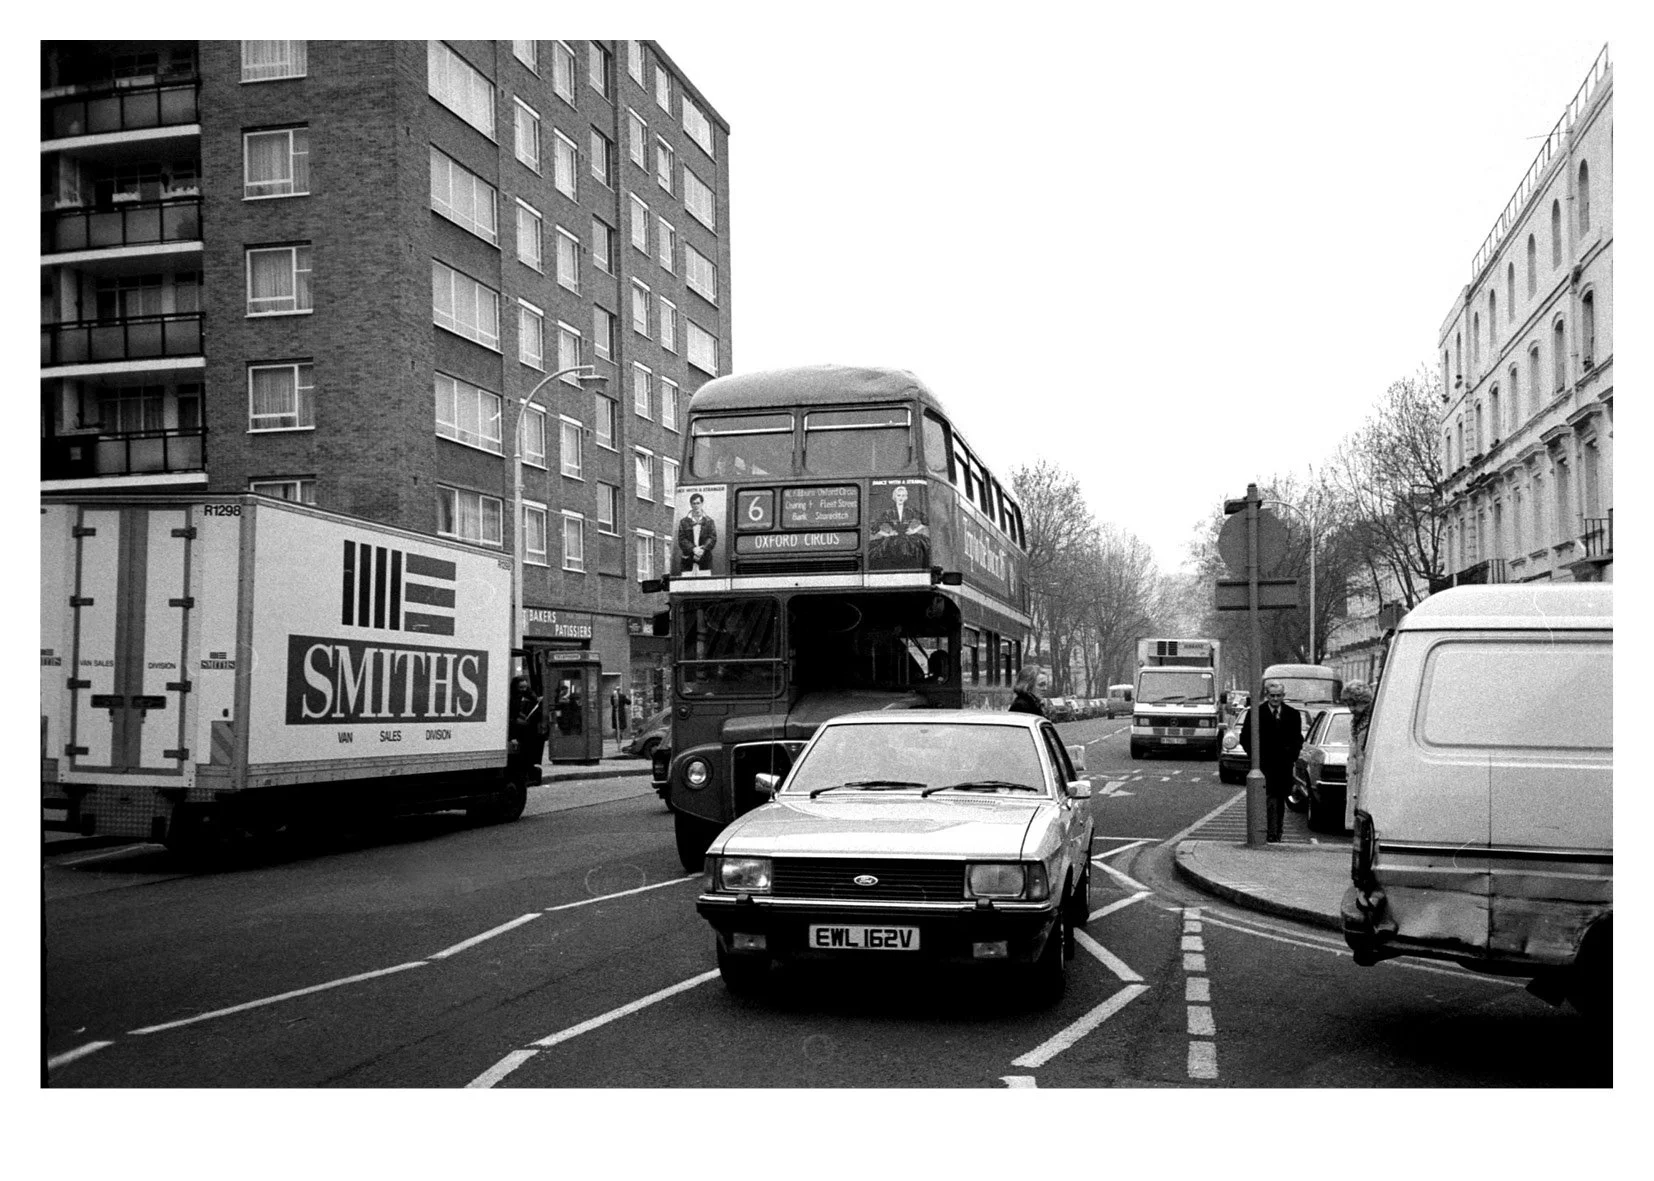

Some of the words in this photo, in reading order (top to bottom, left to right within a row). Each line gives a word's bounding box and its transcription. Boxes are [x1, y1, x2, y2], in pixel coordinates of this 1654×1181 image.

[748, 496, 764, 521] 6
[820, 499, 837, 508] Fleet
[838, 498, 858, 508] Street
[204, 505, 241, 516] R1298
[755, 534, 798, 548] OXFORD
[804, 532, 840, 546] CIRCUS
[529, 609, 557, 623] BAKERS
[555, 624, 592, 638] PATISSIERS
[302, 643, 479, 719] SMITHS
[338, 732, 353, 743] VAN
[380, 730, 401, 742] SALES
[426, 729, 451, 740] DIVISION
[816, 928, 859, 947] EWL
[864, 929, 912, 948] 162V
